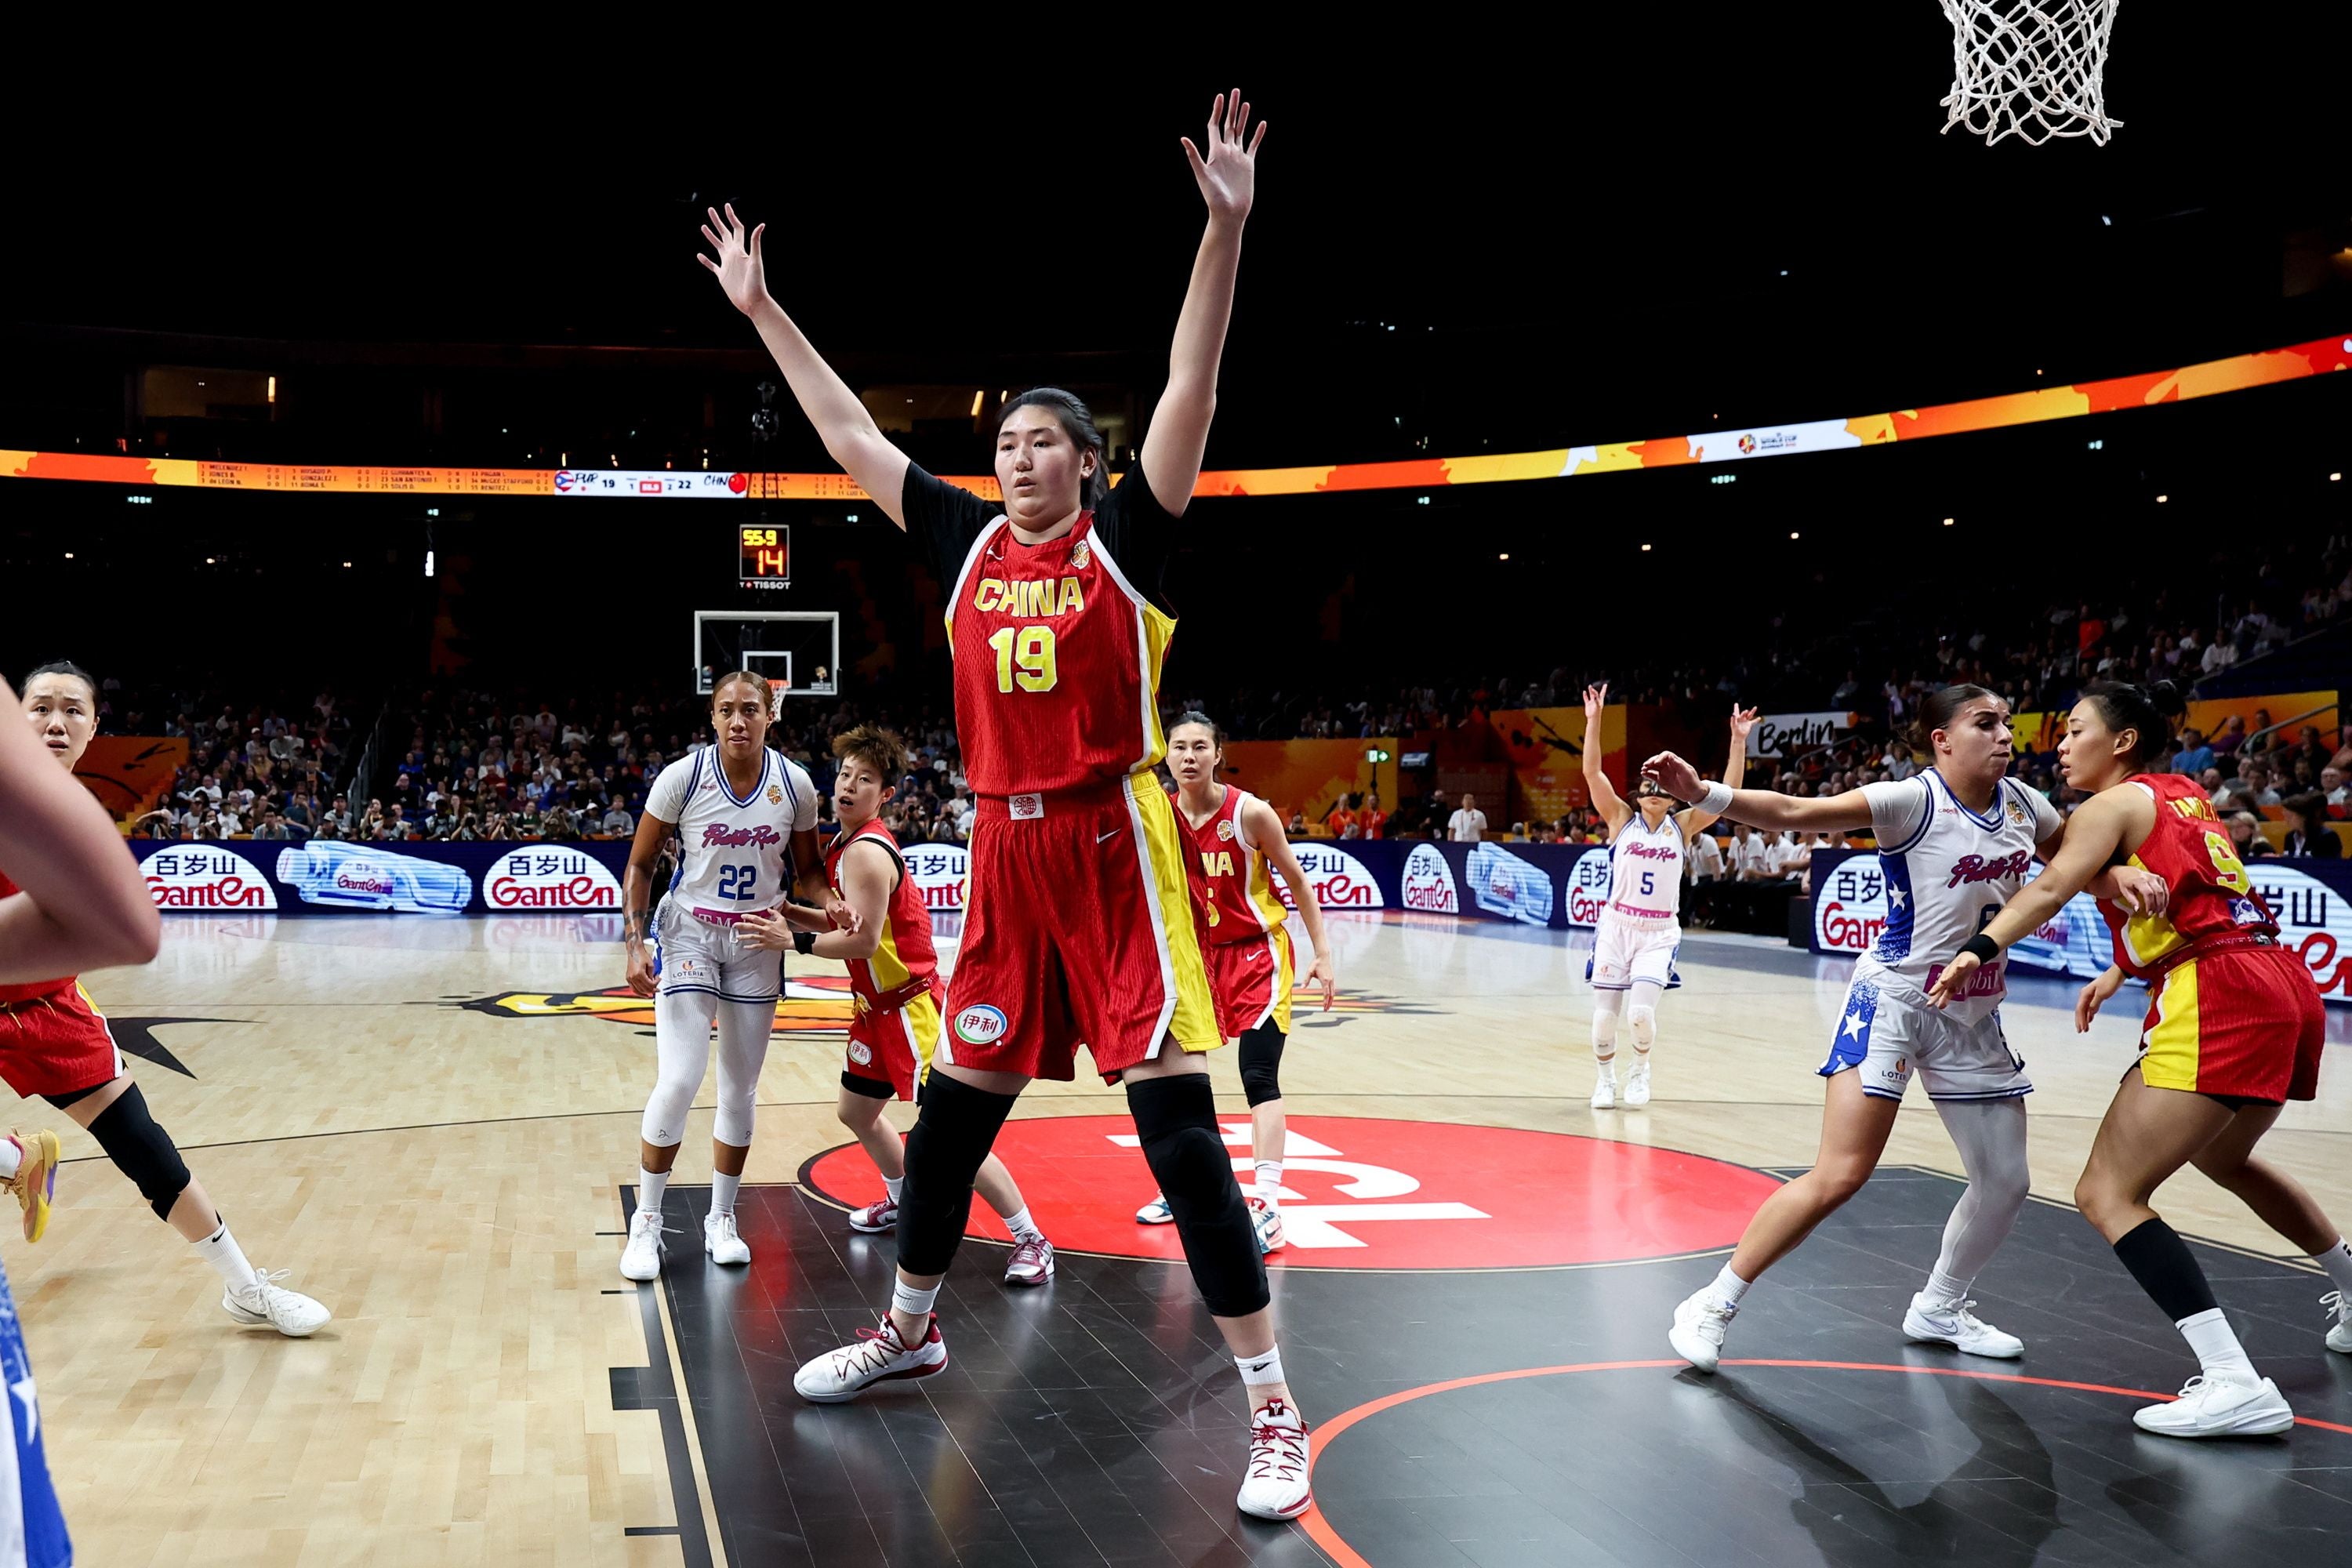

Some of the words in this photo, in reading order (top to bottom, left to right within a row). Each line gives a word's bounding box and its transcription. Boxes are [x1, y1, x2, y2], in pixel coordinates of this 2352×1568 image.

[704, 475, 728, 485] CHN
[758, 550, 783, 575] 14
[753, 581, 791, 590] TISSOT
[974, 577, 1084, 617] CHINA
[988, 626, 1058, 693] 19
[1758, 718, 1835, 754] Berlin
[157, 855, 236, 876] 百岁山
[510, 855, 586, 876] 百岁山
[1297, 854, 1345, 873] 岁山
[1412, 855, 1443, 876] 百岁山
[1580, 861, 1610, 887] 百岁
[2205, 830, 2252, 896] 9
[718, 865, 757, 901] 22
[1641, 872, 1654, 895] 5
[1838, 870, 1882, 902] 百岁
[2252, 884, 2326, 927] 岁山
[1824, 902, 1886, 948] Gan
[962, 1014, 998, 1034] 伊利
[851, 1044, 868, 1059] 伊利
